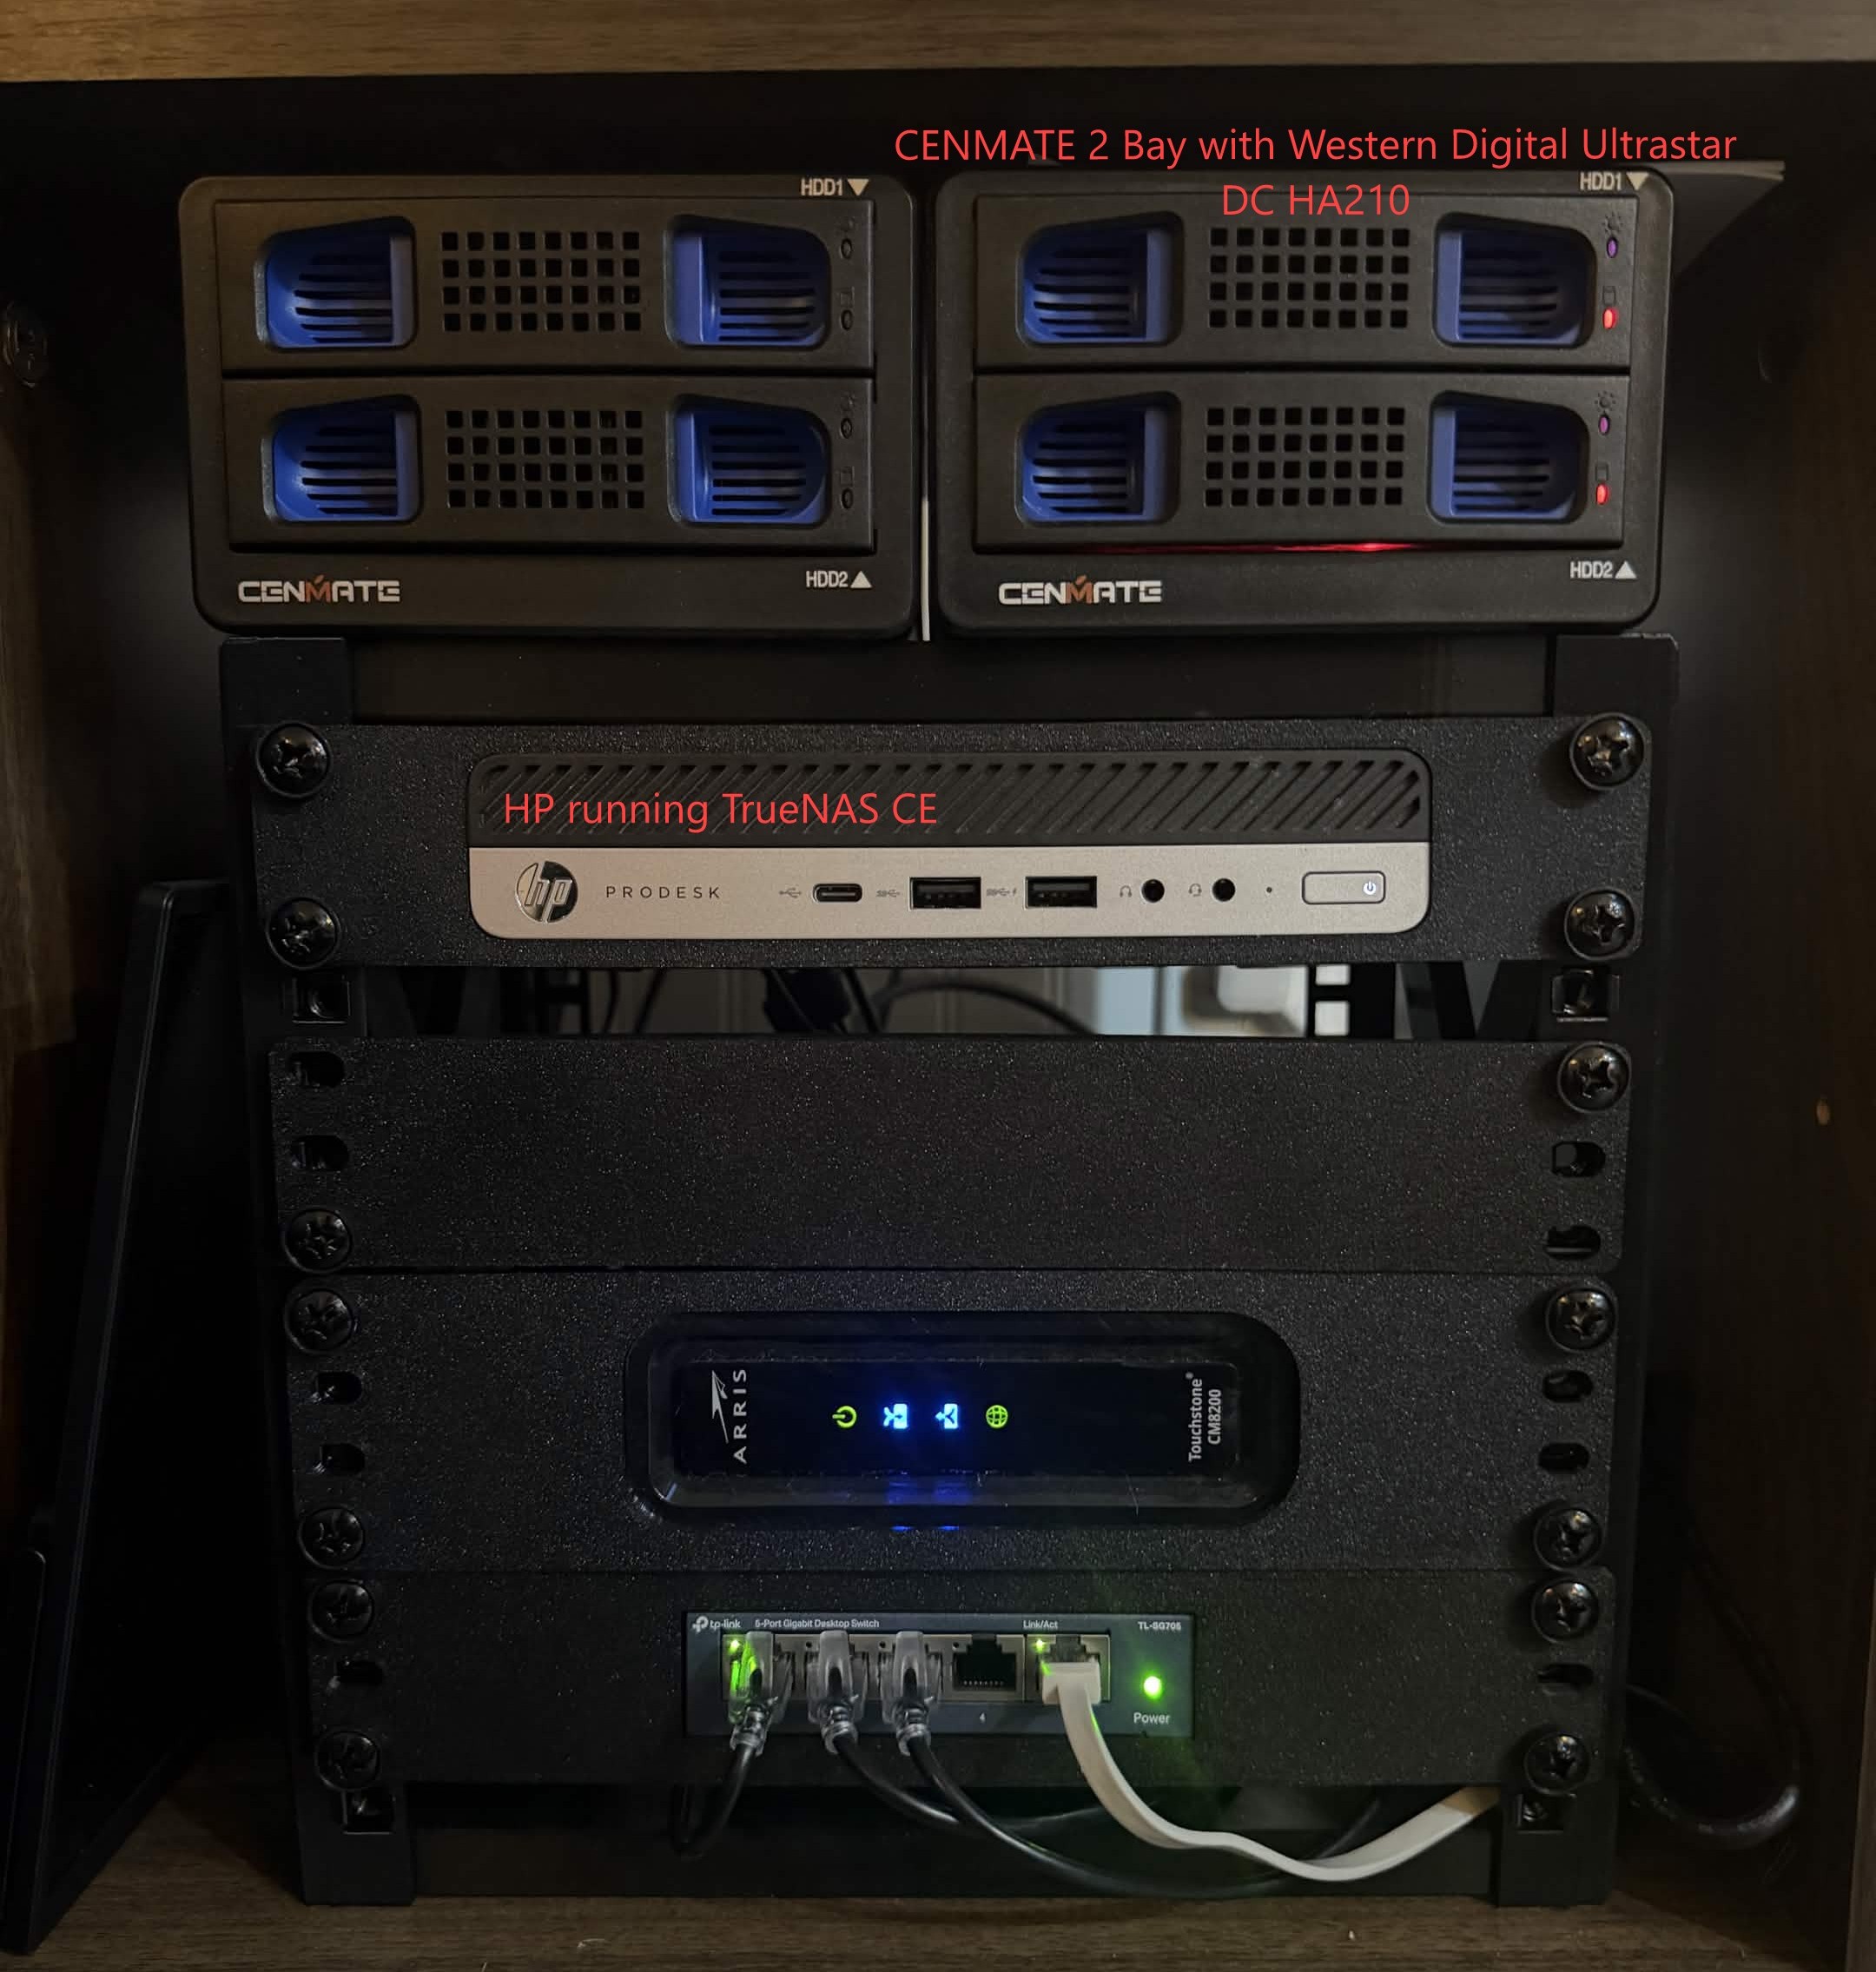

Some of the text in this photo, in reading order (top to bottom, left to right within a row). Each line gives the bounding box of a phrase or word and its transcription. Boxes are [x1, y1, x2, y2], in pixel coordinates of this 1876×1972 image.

[800, 177, 843, 197] HDD1
[1580, 171, 1622, 191] HDD1
[805, 570, 849, 588] HDD2
[1569, 560, 1613, 580] HDD2
[237, 575, 400, 605] CENMATE
[998, 575, 1162, 605] CENMATE
[605, 885, 721, 899] PRODESK
[732, 1369, 747, 1464] ARRIS
[1207, 1388, 1222, 1445] CM8200
[710, 1619, 741, 1630] tp-link
[783, 1619, 813, 1629] Gigabit
[814, 1619, 850, 1629] Desktop
[851, 1619, 880, 1628] Switch
[1022, 1619, 1059, 1630] Link/Act
[979, 1712, 986, 1722] 4
[1133, 1711, 1171, 1725] Power
